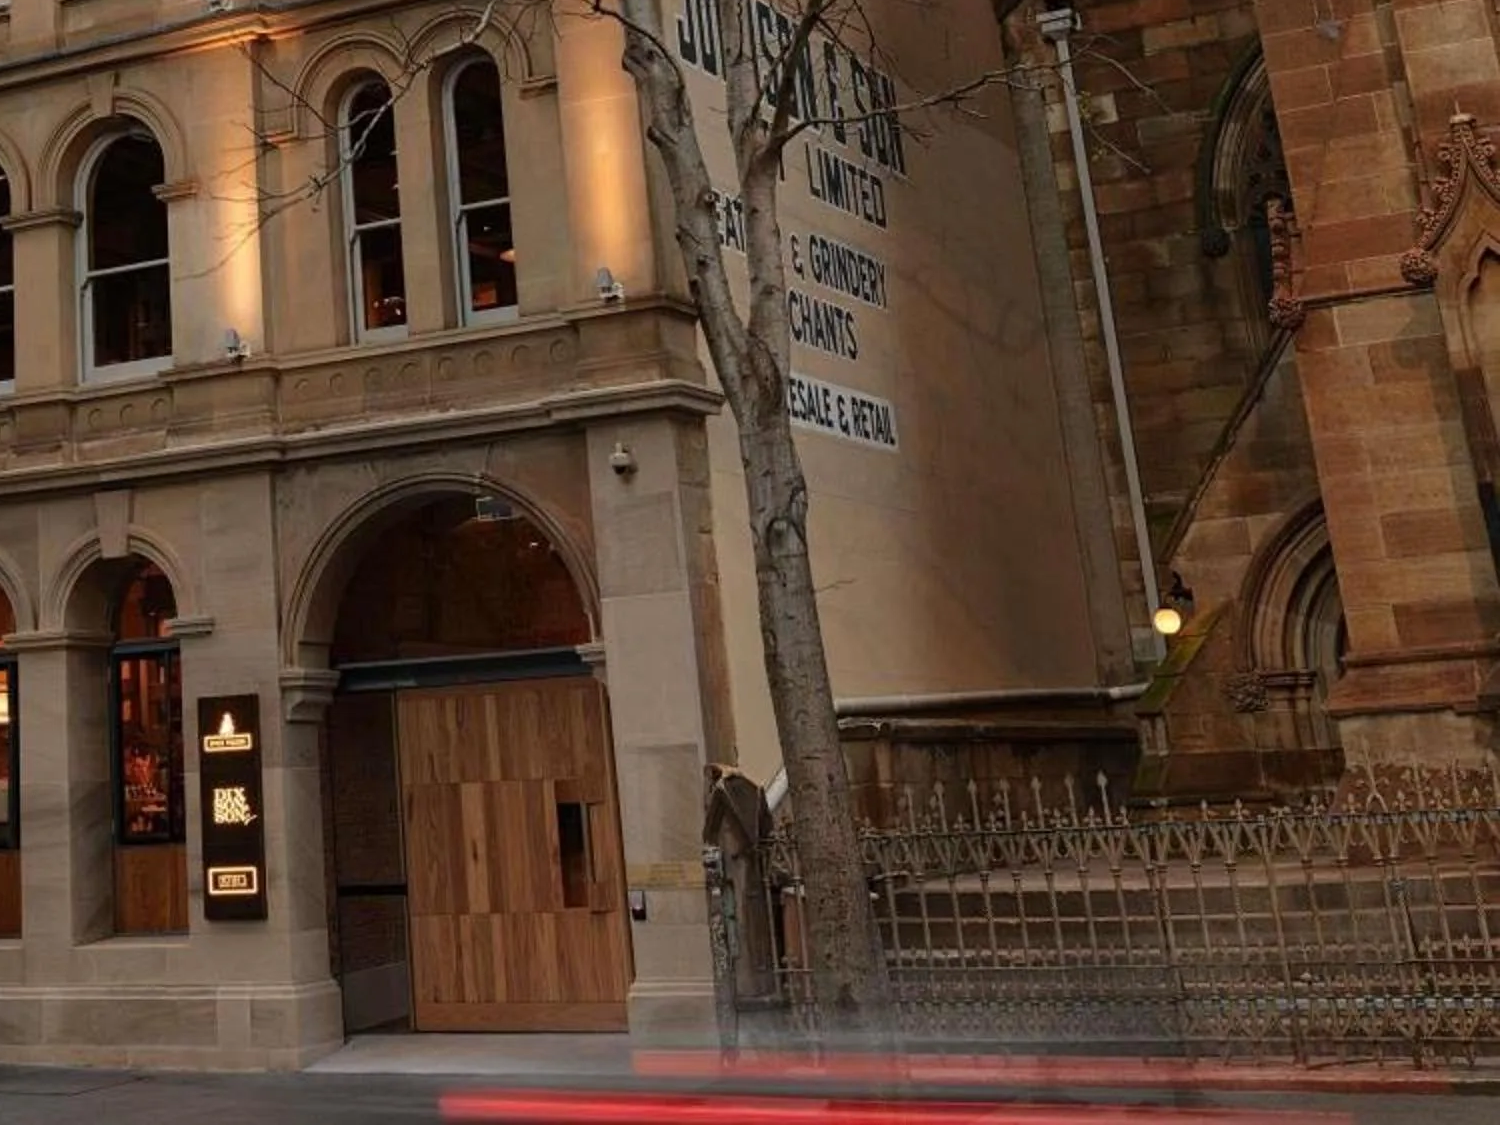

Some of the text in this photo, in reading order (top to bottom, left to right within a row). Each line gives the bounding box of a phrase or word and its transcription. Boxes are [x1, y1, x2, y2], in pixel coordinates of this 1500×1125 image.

[805, 142, 887, 228] LIMITED
[809, 235, 886, 309] GRINDERY
[789, 290, 858, 360] CHANTS
[787, 378, 834, 428] ESALE
[851, 396, 895, 445] RETAIL
